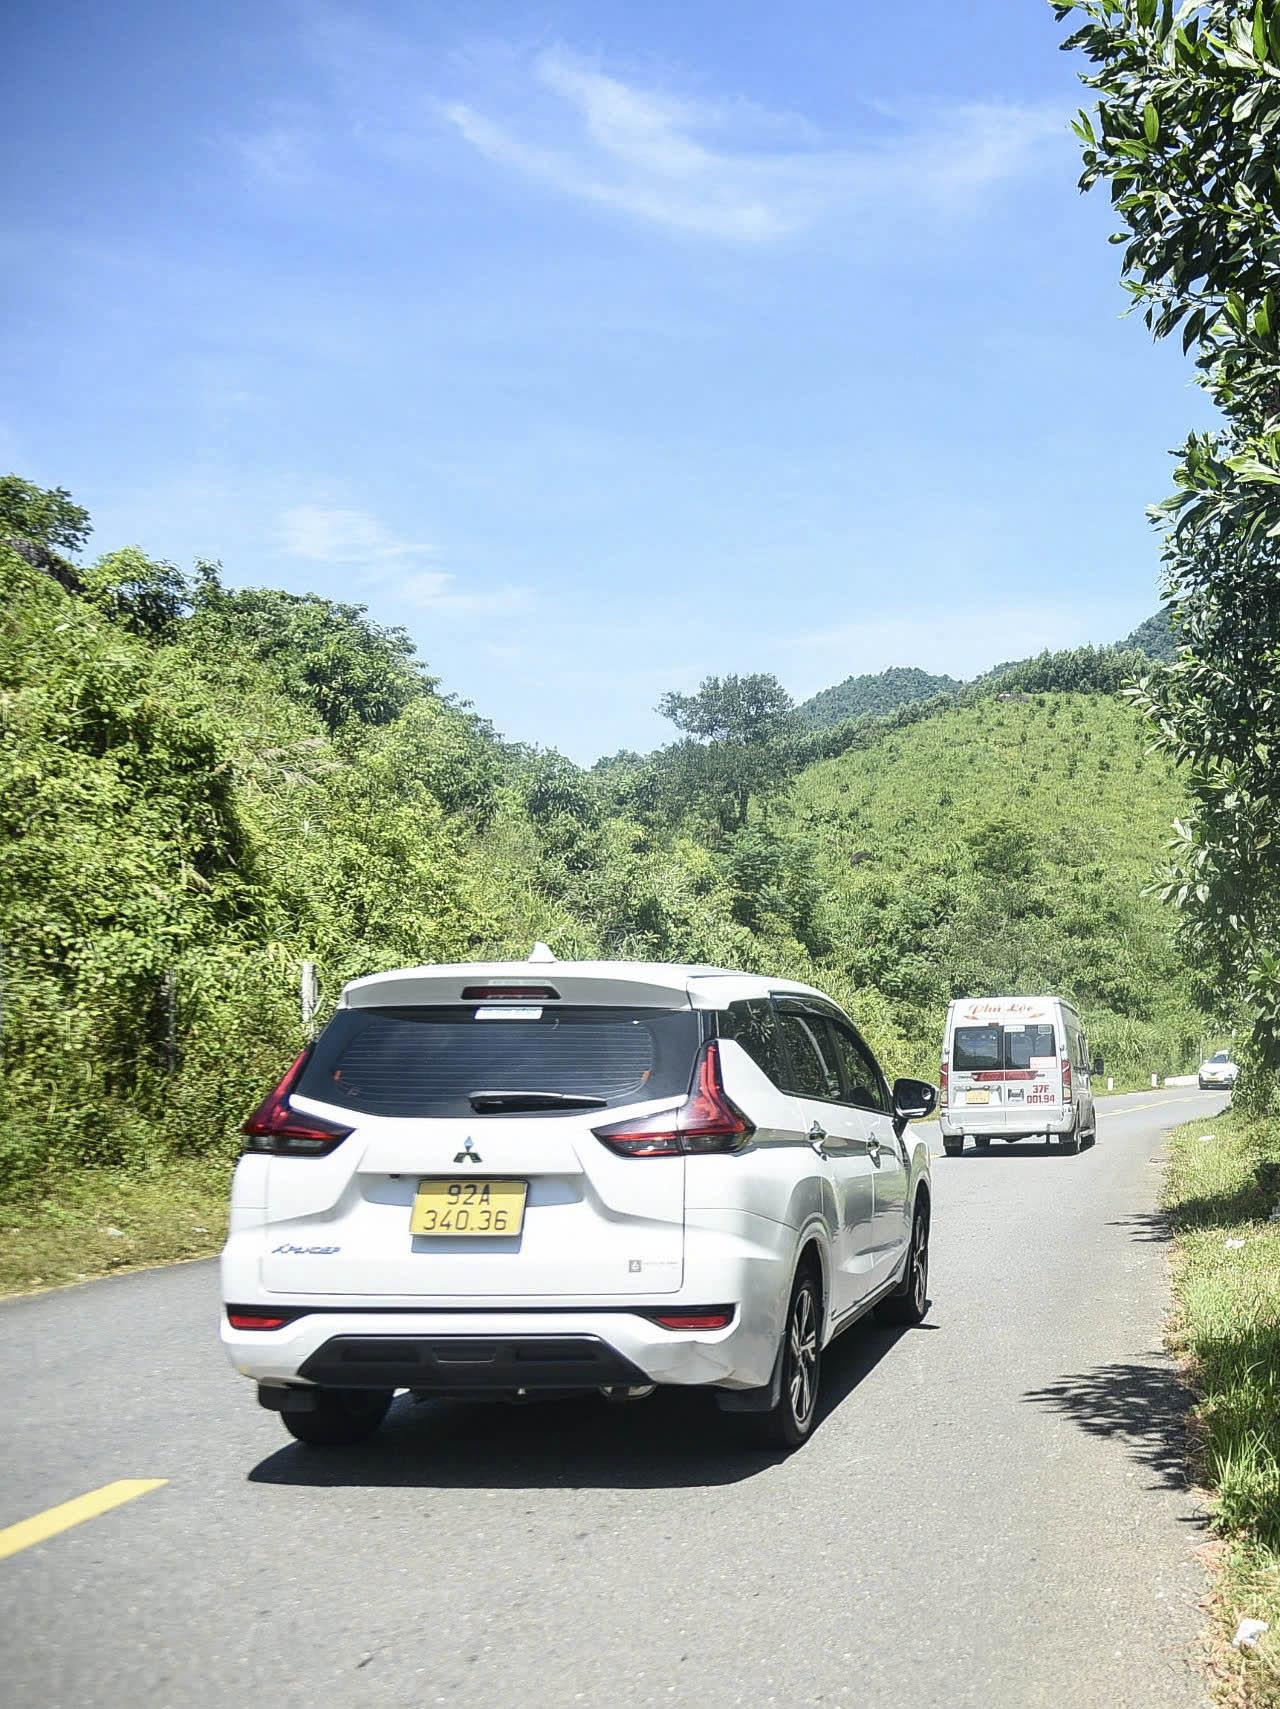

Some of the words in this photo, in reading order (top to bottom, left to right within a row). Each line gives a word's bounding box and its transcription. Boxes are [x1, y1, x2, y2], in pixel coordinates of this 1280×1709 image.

[1032, 1084, 1050, 1094] 37F
[447, 1183, 491, 1206] 92A
[423, 1209, 508, 1231] 340.36
